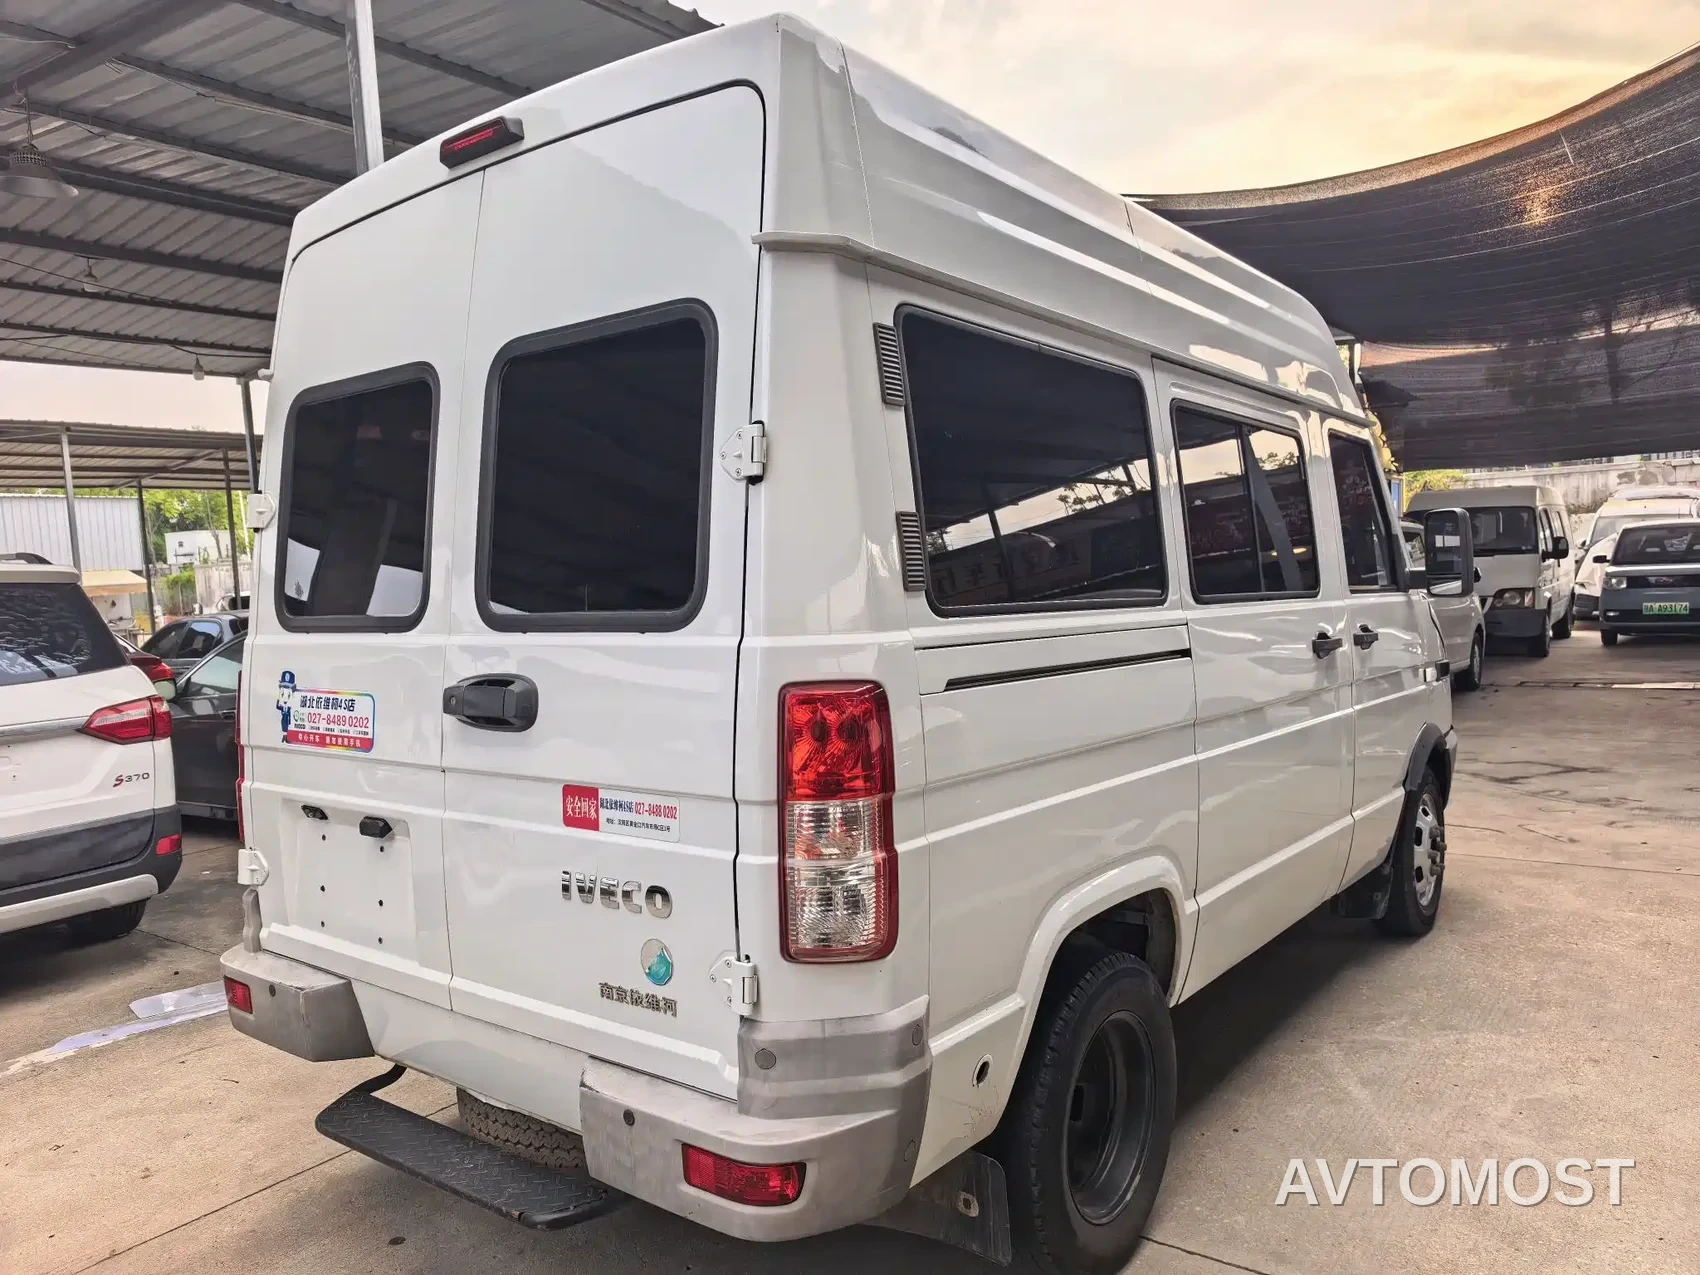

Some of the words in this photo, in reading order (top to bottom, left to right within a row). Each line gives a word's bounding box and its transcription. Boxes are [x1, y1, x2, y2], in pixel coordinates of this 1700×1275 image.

[307, 712, 347, 727] 027-8489
[348, 716, 369, 729] 0202
[112, 772, 150, 788] S370
[565, 795, 597, 820] 安全回家
[662, 805, 678, 820] 0202
[561, 870, 673, 919] IVECO
[599, 982, 678, 1018] 南京依维柯
